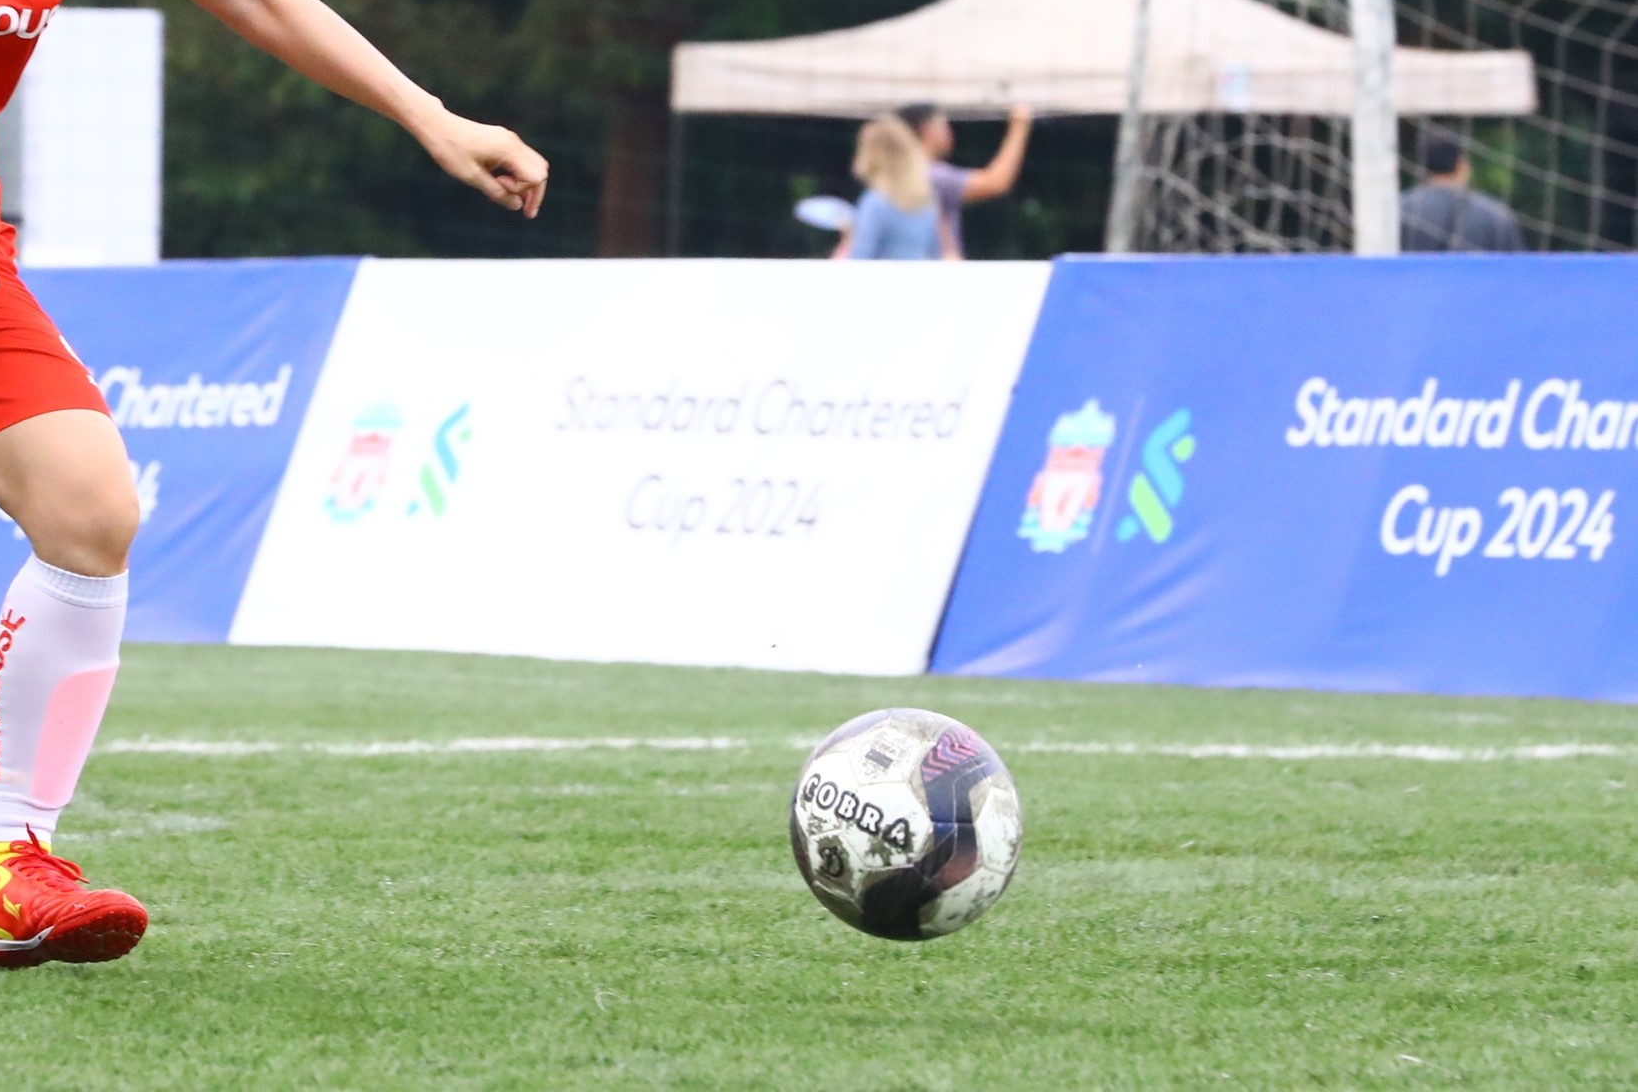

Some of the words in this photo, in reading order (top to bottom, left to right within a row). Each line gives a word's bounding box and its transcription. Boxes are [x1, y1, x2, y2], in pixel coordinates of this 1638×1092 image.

[555, 375, 752, 434] Standard
[752, 377, 972, 440] Chartered
[1285, 376, 1522, 449] Standard
[626, 472, 708, 556] Cup
[712, 476, 824, 540] 2024
[1380, 484, 1483, 577] Cup
[1483, 486, 1616, 562] 2024
[803, 773, 914, 850] COBRA
